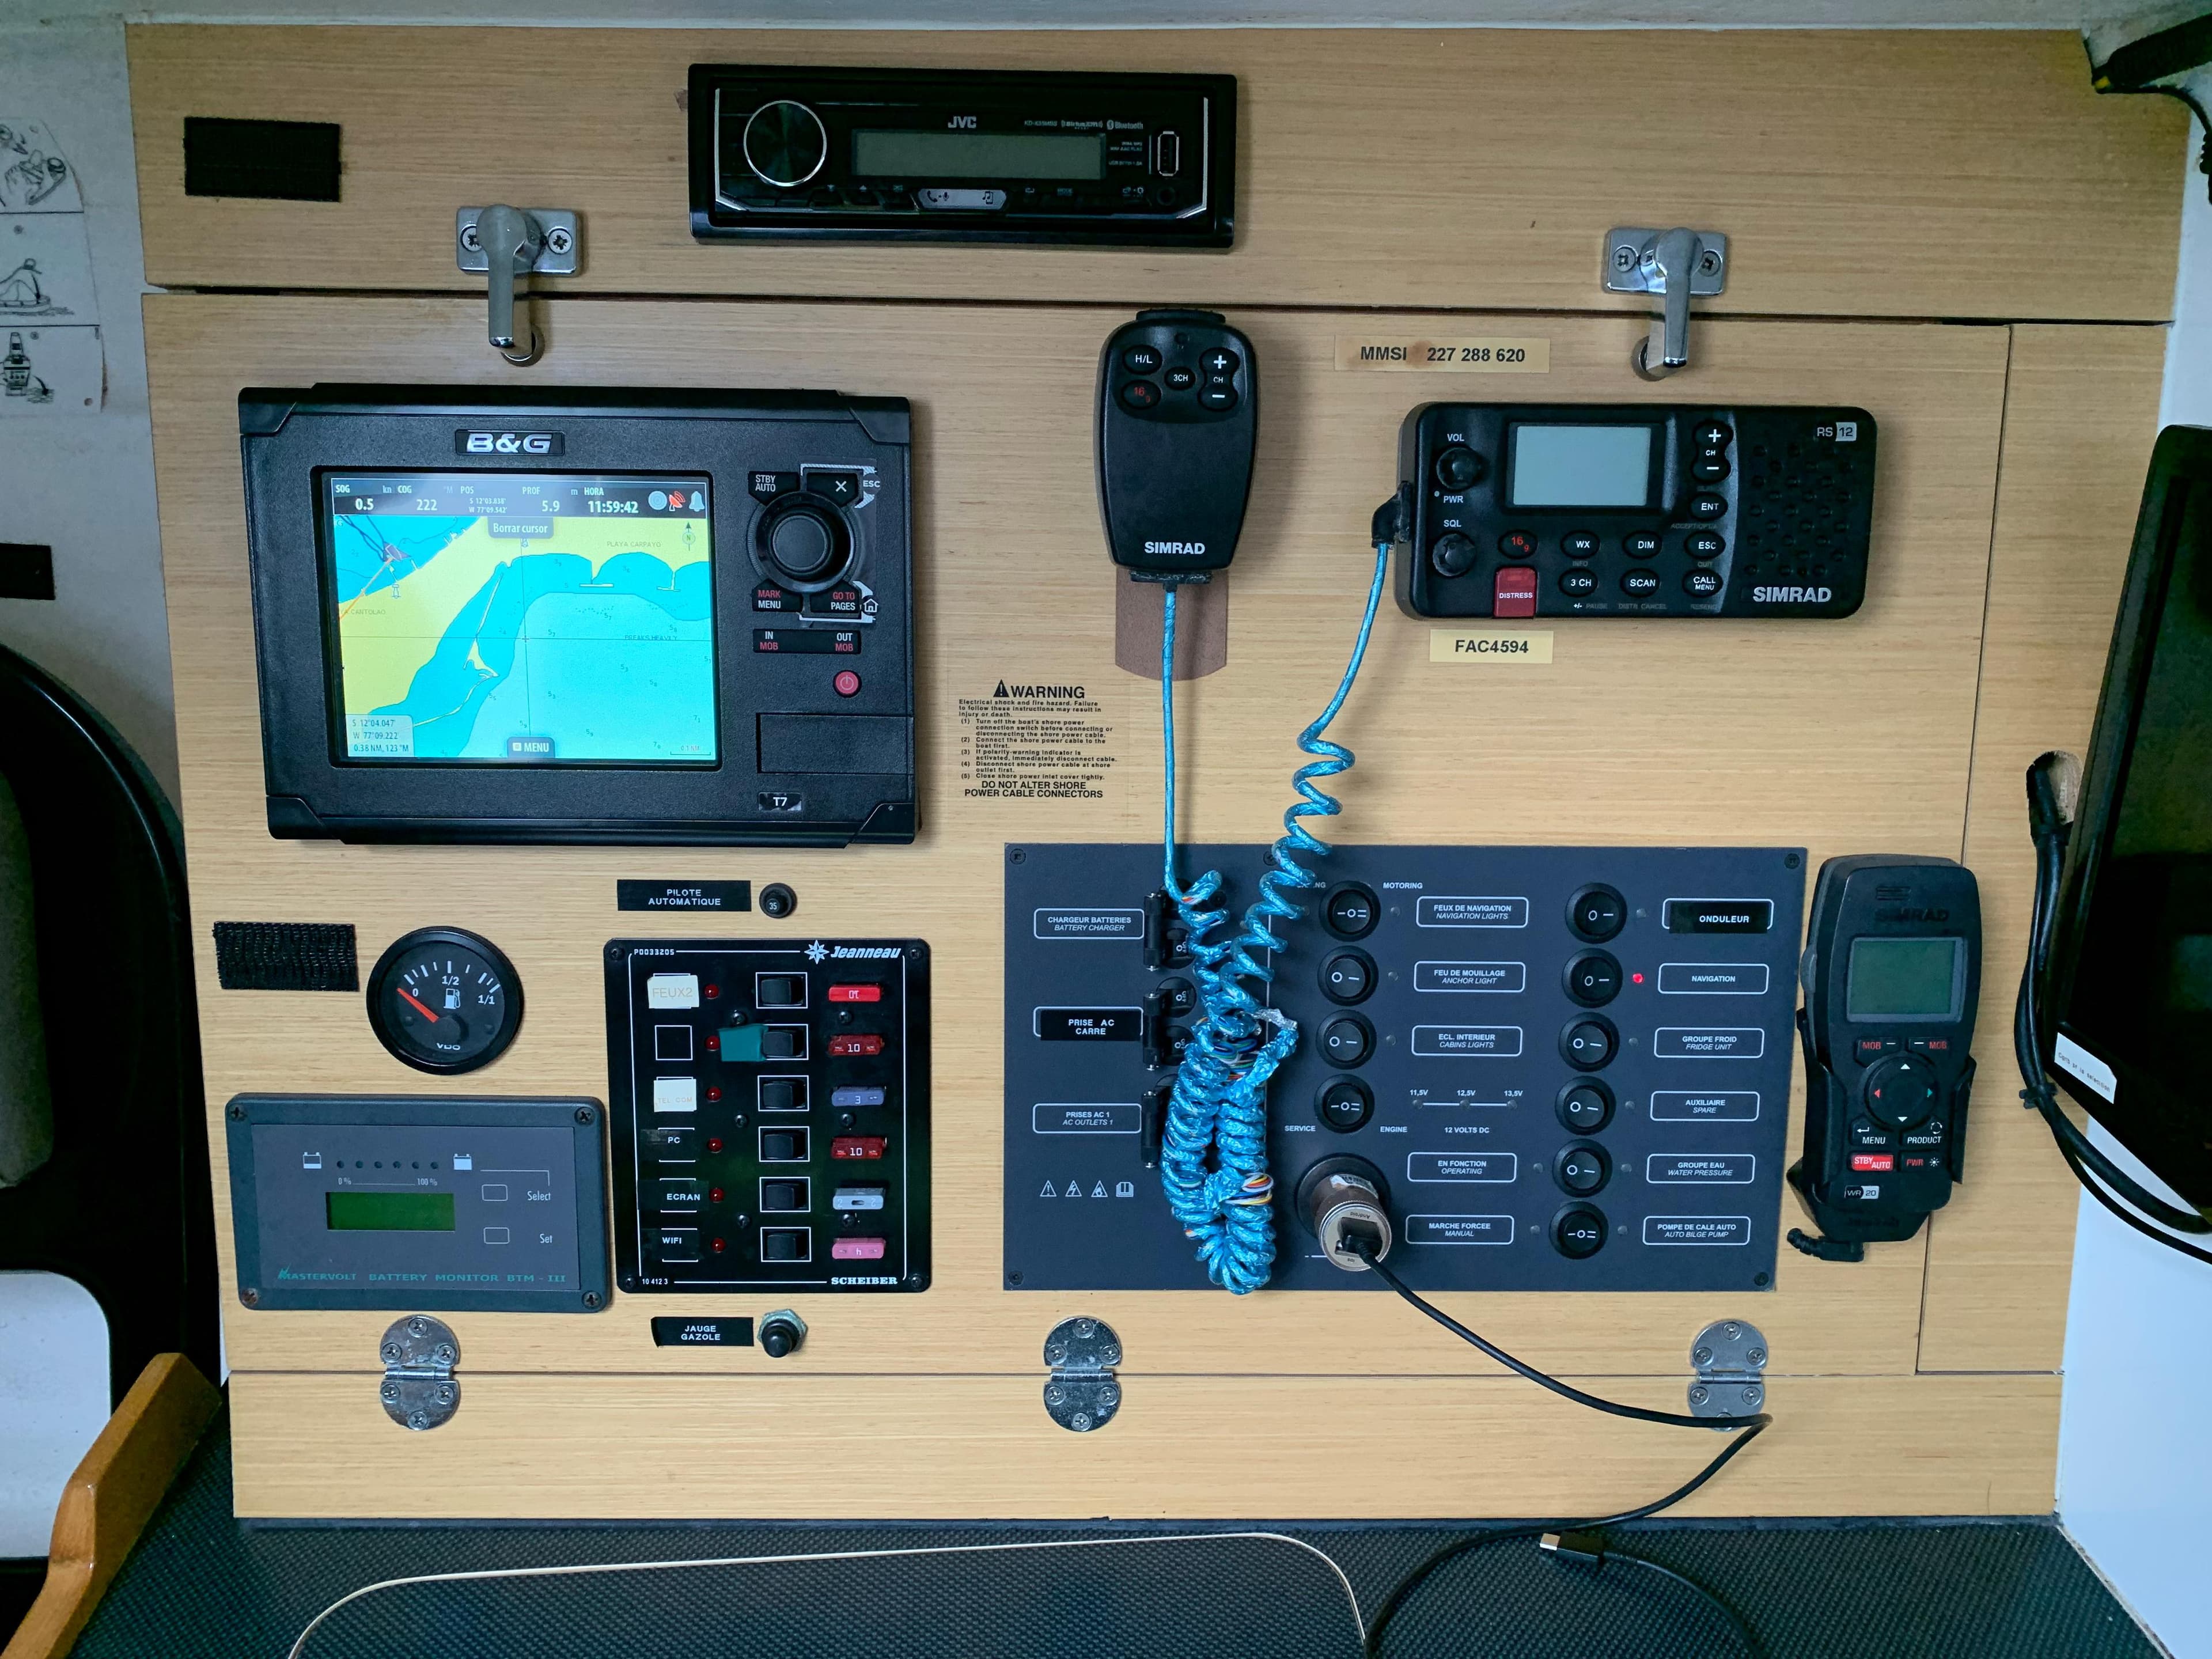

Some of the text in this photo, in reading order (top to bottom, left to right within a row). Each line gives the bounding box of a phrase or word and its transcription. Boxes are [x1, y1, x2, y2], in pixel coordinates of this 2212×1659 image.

[948, 116, 976, 128] JVC
[1136, 355, 1153, 363] H/L
[1361, 347, 1525, 362] MMSI 227 288 620
[1817, 425, 1853, 438] RS 12
[467, 433, 551, 455] B&G
[755, 474, 776, 483] STBY
[335, 484, 350, 493] SOG
[397, 485, 412, 494] COG
[461, 486, 474, 494] POS
[522, 487, 540, 495] PROF
[584, 487, 604, 496] HORA
[755, 483, 777, 493] AUTO
[355, 498, 374, 510] 0.5
[416, 499, 437, 510] 222
[542, 500, 560, 512] 5.9
[588, 500, 639, 514] 11:59:42
[493, 523, 548, 533] Borrar cursor
[1444, 520, 1461, 528] SQL
[1145, 541, 1205, 554] SIMRAD
[1638, 541, 1654, 549] DIM
[1699, 541, 1715, 550] ESC
[1630, 579, 1656, 587] SCAN
[1694, 577, 1715, 585] CALL
[758, 590, 781, 598] MARK
[832, 592, 855, 601] GO TO
[1498, 590, 1533, 599] DISTRESS
[1753, 587, 1831, 603] SIMRAD
[758, 600, 781, 609] MENU
[831, 602, 855, 611] PAGES
[765, 631, 773, 639] IN
[836, 633, 853, 642] OUT
[759, 642, 778, 651] MOB
[835, 642, 853, 652] MOB
[1455, 640, 1529, 653] FAC4594
[1010, 685, 1085, 699] WARNING
[524, 743, 549, 752] MENU
[1002, 789, 1035, 797] CABLE
[1037, 789, 1103, 798] CONNECTORS
[773, 797, 788, 807] T7
[828, 946, 902, 958] Jeanneau
[442, 976, 459, 986] 1/2
[478, 995, 495, 1005] 1/1
[1907, 1136, 1942, 1144] PRODUCT
[528, 1191, 551, 1200] Select
[540, 1234, 552, 1243] Set
[369, 1272, 427, 1281] BATTERY
[435, 1274, 498, 1282] MONITOR
[683, 1325, 716, 1334] JAUGE
